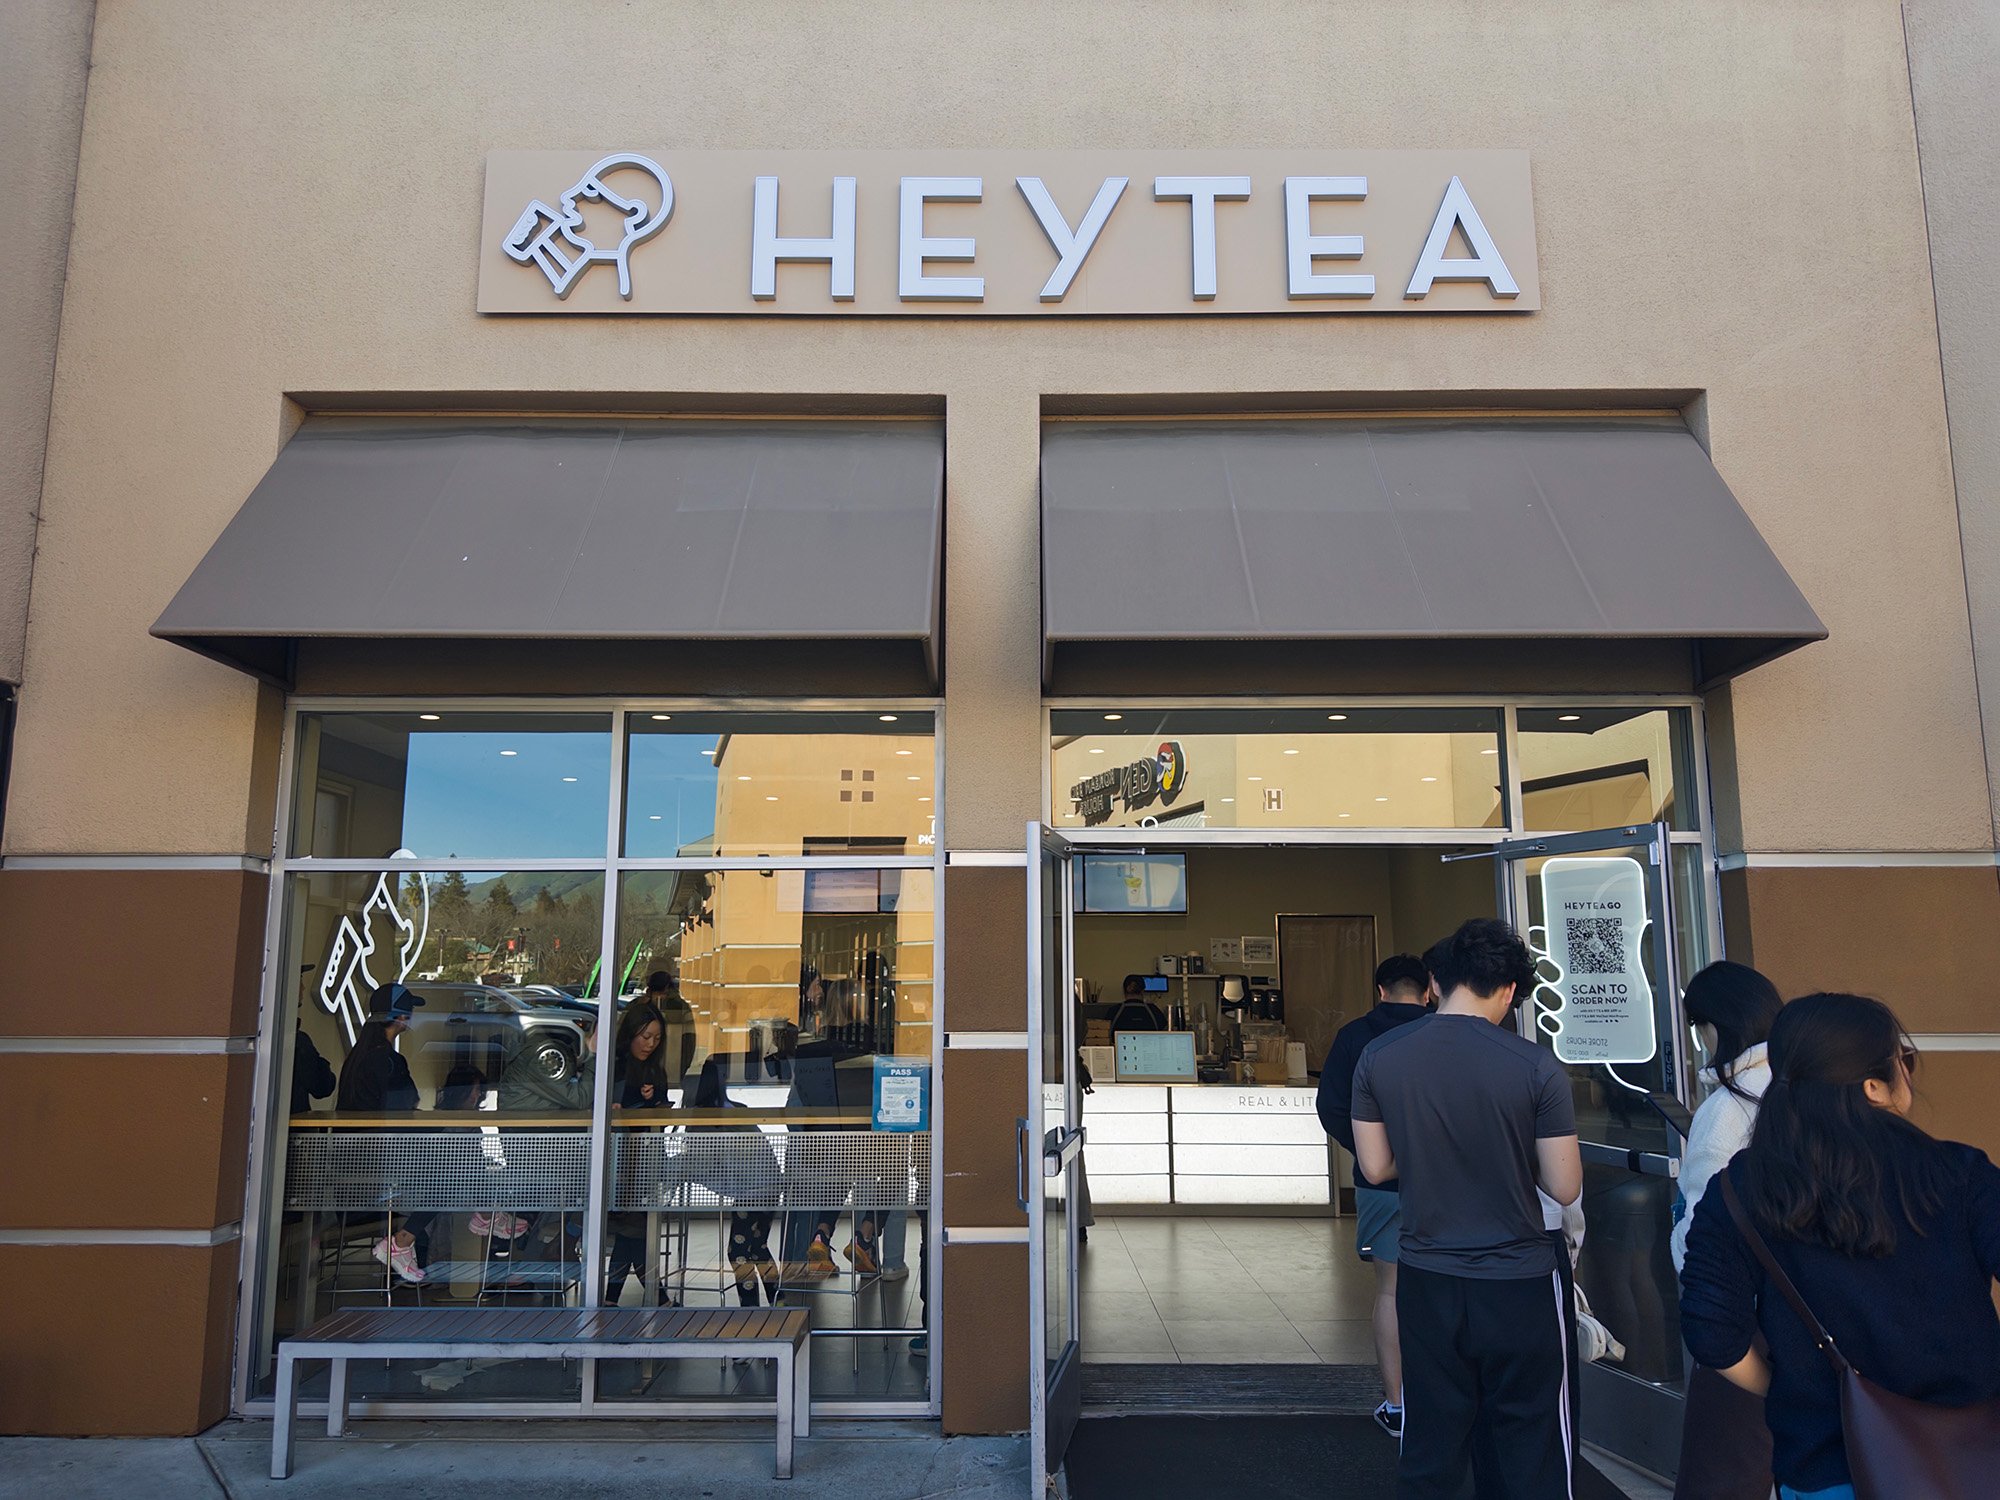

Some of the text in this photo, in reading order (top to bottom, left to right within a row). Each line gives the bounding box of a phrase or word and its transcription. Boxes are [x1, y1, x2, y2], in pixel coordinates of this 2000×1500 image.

[751, 175, 1521, 302] HEYTEA
[1571, 983, 1628, 995] SCAN TO
[1572, 996, 1628, 1005] ORDER NOW
[1665, 1045, 1673, 1083] PUSH
[890, 1068, 912, 1076] PASS
[1238, 1096, 1314, 1107] REAL & LIT
